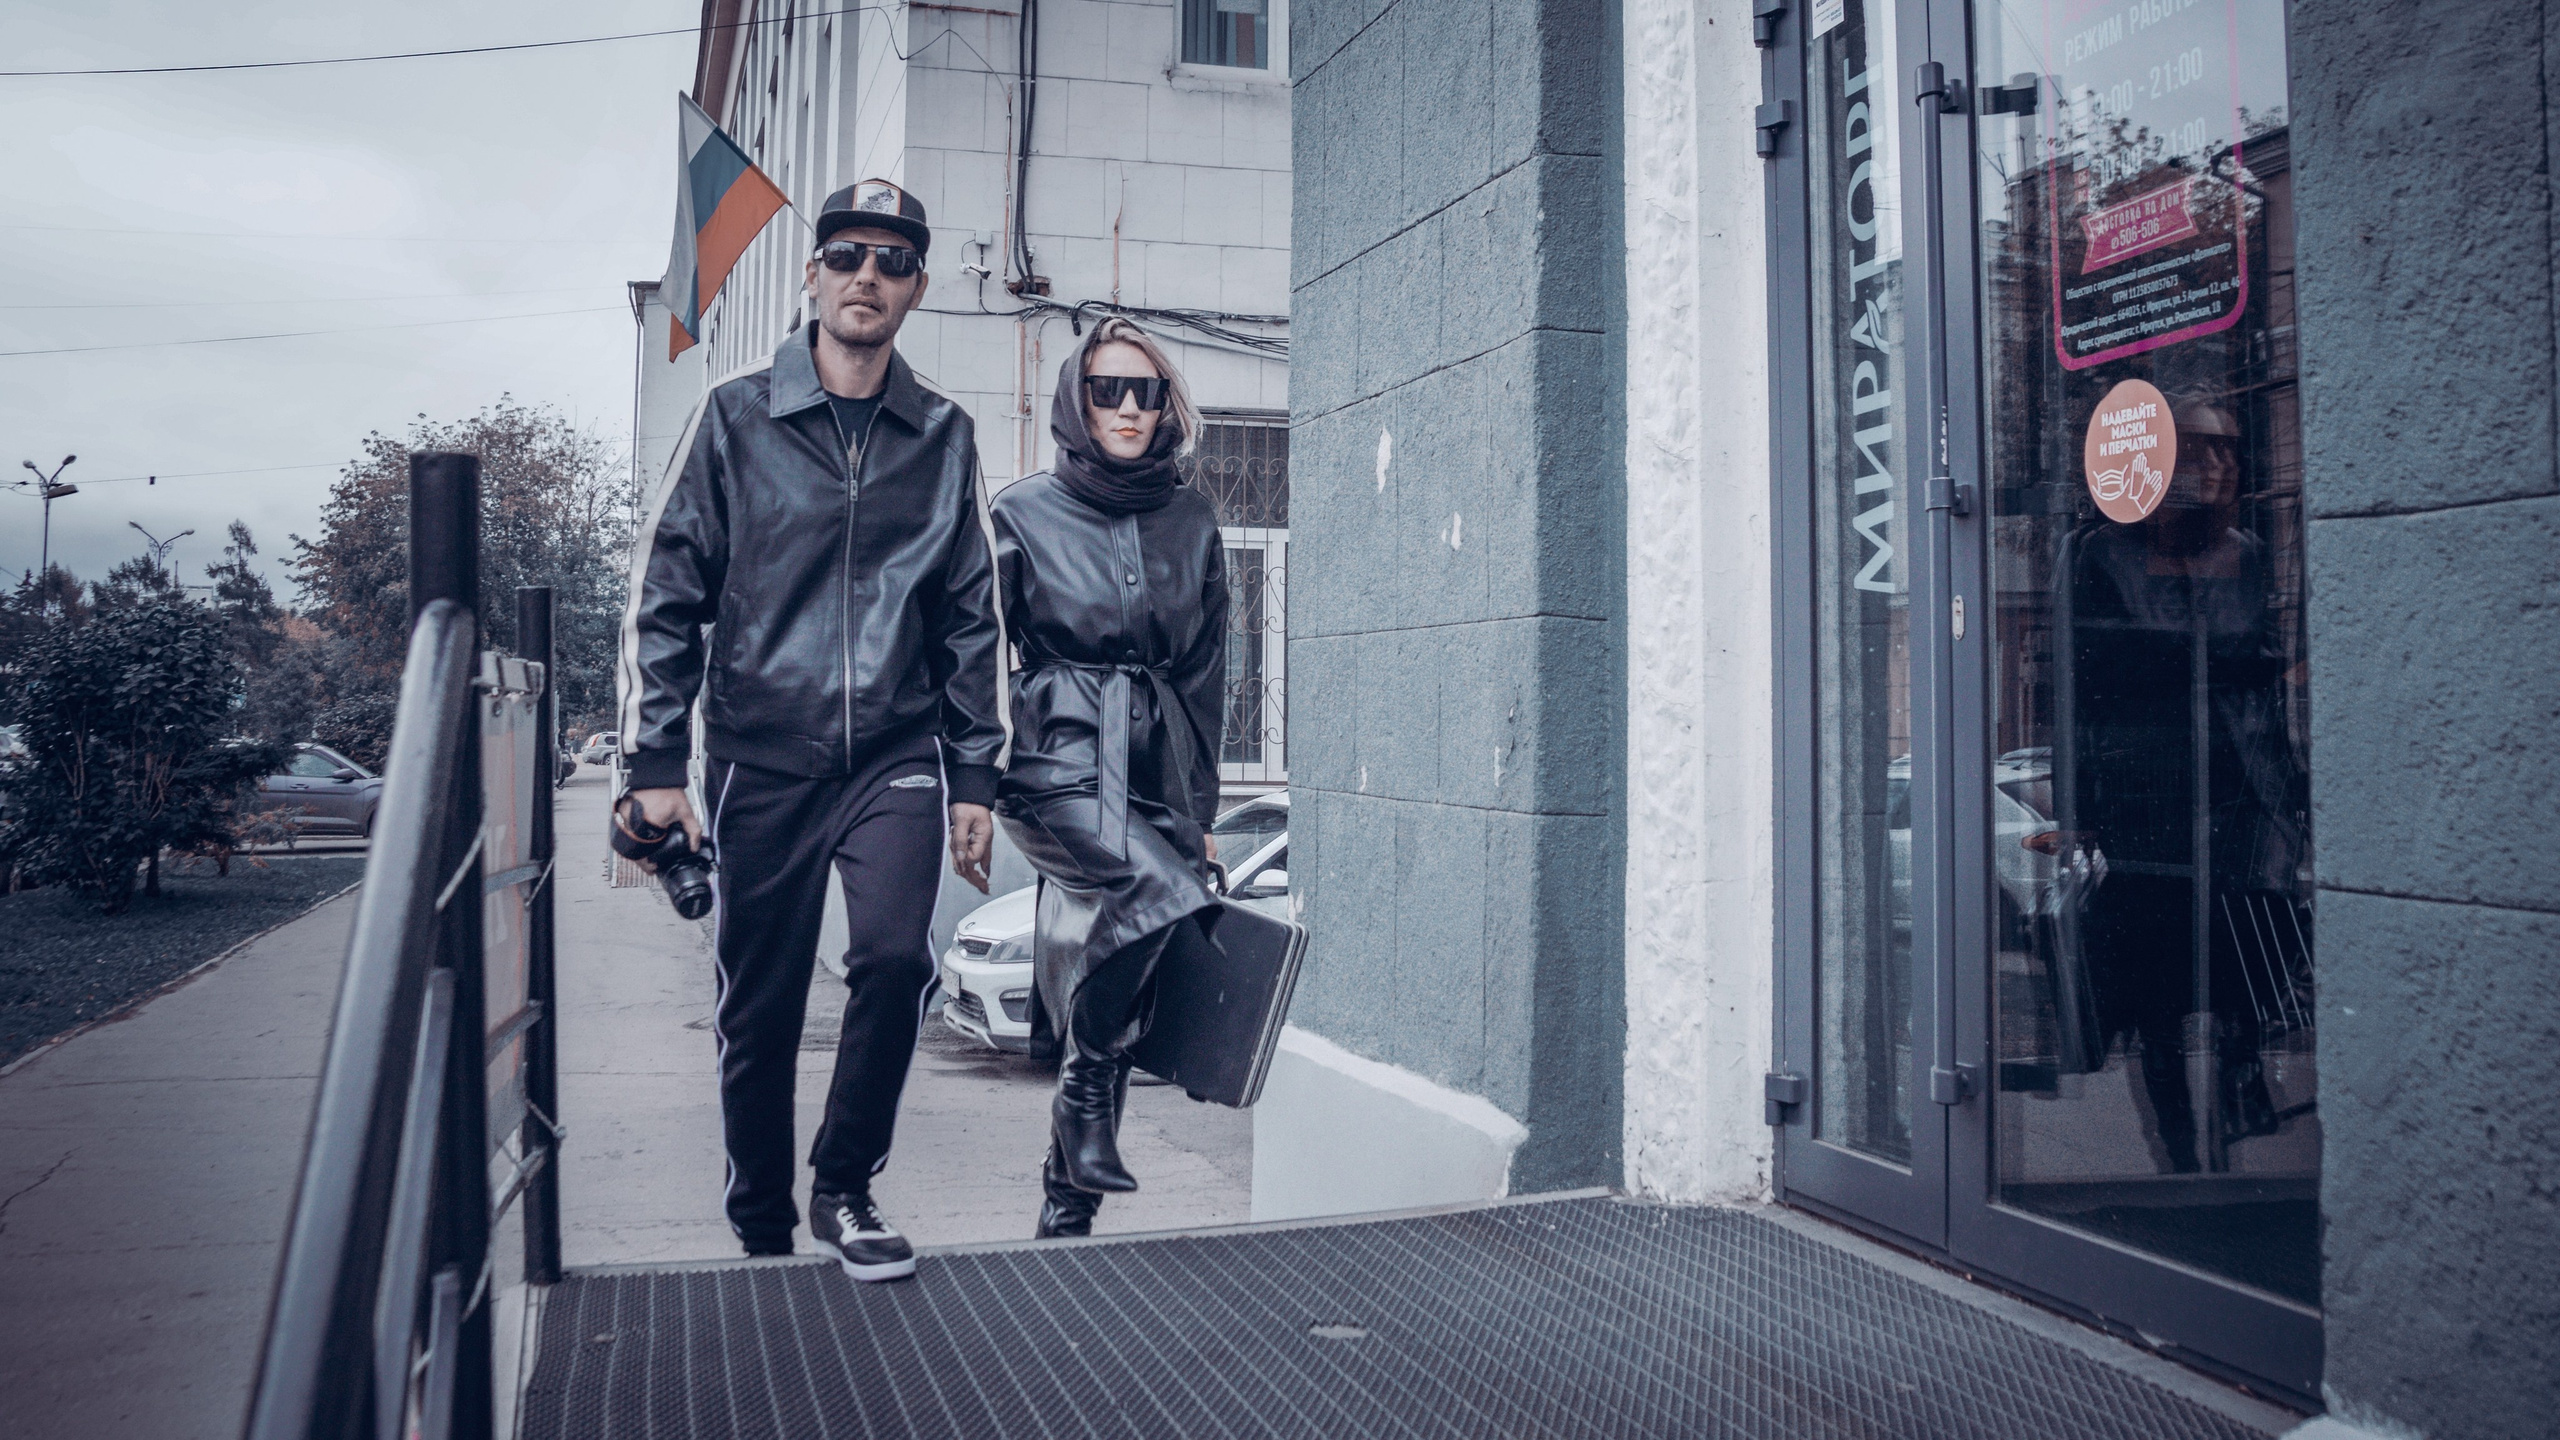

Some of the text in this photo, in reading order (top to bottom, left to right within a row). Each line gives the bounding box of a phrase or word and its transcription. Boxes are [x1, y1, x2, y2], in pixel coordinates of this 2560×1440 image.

[2064, 0, 2199, 67] РЕЖИМ РАБО
[2150, 46, 2203, 101] 21:00
[2119, 217, 2160, 247] 506-506
[1842, 57, 1895, 594] МИРАТОРГ
[2101, 402, 2157, 427] НАДЕВАЙТЕ
[2099, 434, 2158, 457] И ПЕРЧАТКИ
[2111, 421, 2147, 440] МАСКИ
